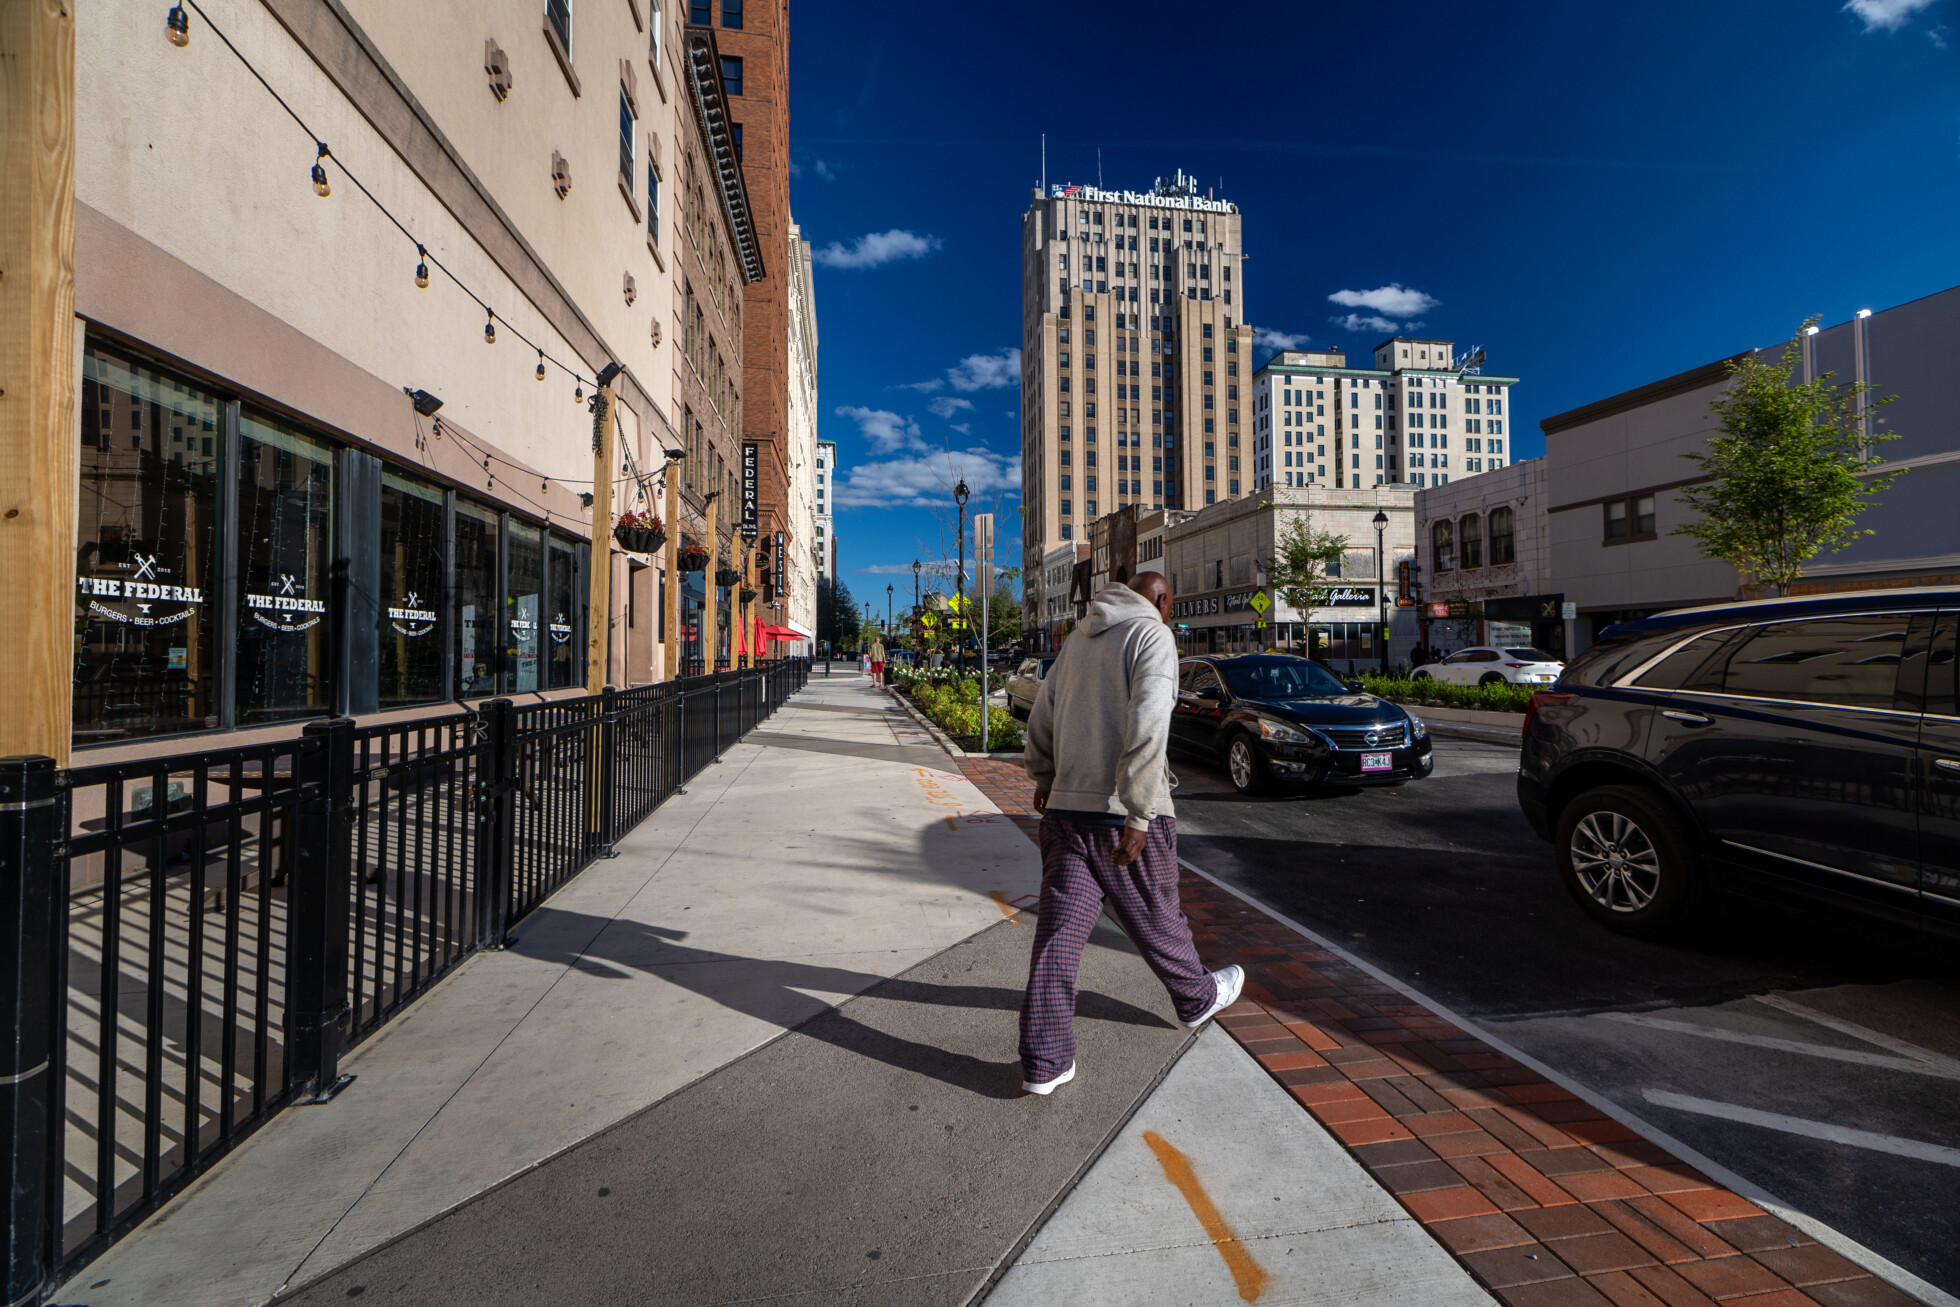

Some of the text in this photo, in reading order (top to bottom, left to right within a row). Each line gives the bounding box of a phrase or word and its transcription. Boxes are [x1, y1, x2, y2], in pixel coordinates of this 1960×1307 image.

[1085, 186, 1233, 214] First National Bank
[744, 447, 755, 519] FEDERAL
[79, 577, 203, 603] THE FEDERAL
[1329, 588, 1370, 606] Galleria
[89, 600, 195, 626] BURGERS BEER COCKTAILS
[247, 594, 326, 613] THE FEDERAL
[388, 607, 437, 621] THE FEDERAL
[1170, 598, 1217, 617] SILVERS
